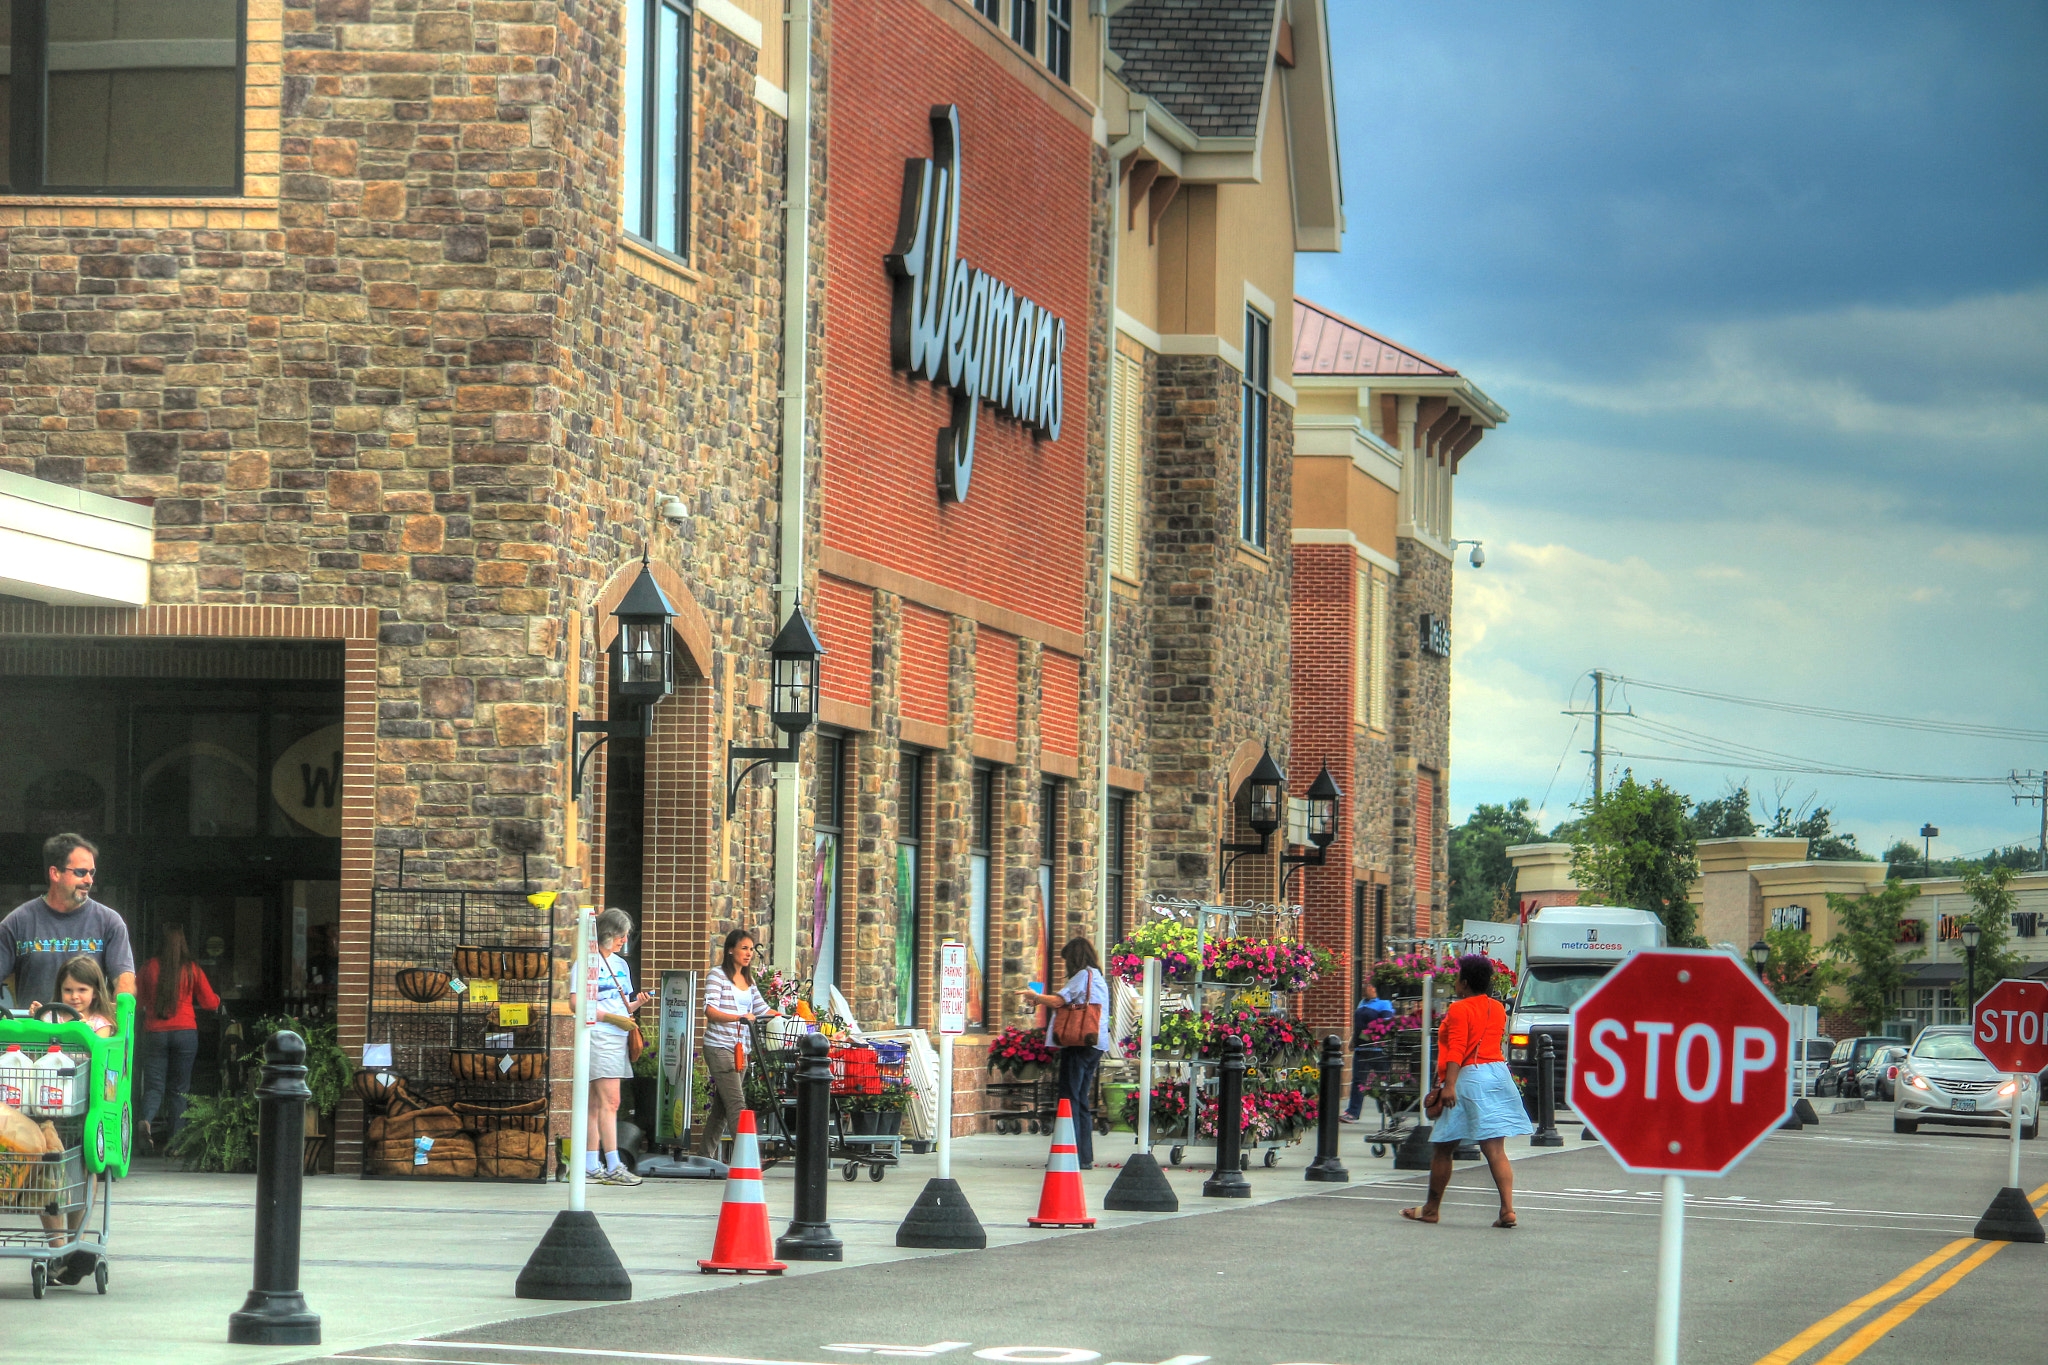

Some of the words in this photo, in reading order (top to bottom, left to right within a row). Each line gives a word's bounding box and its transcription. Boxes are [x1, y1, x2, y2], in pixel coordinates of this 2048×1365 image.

[890, 103, 1065, 503] Wegmans
[1561, 942, 1622, 950] metroaccess
[944, 966, 963, 978] PARKING
[942, 987, 963, 999] STANDING
[941, 1000, 951, 1014] FIRE
[952, 1000, 964, 1014] LANE
[1583, 1018, 1776, 1104] STOP
